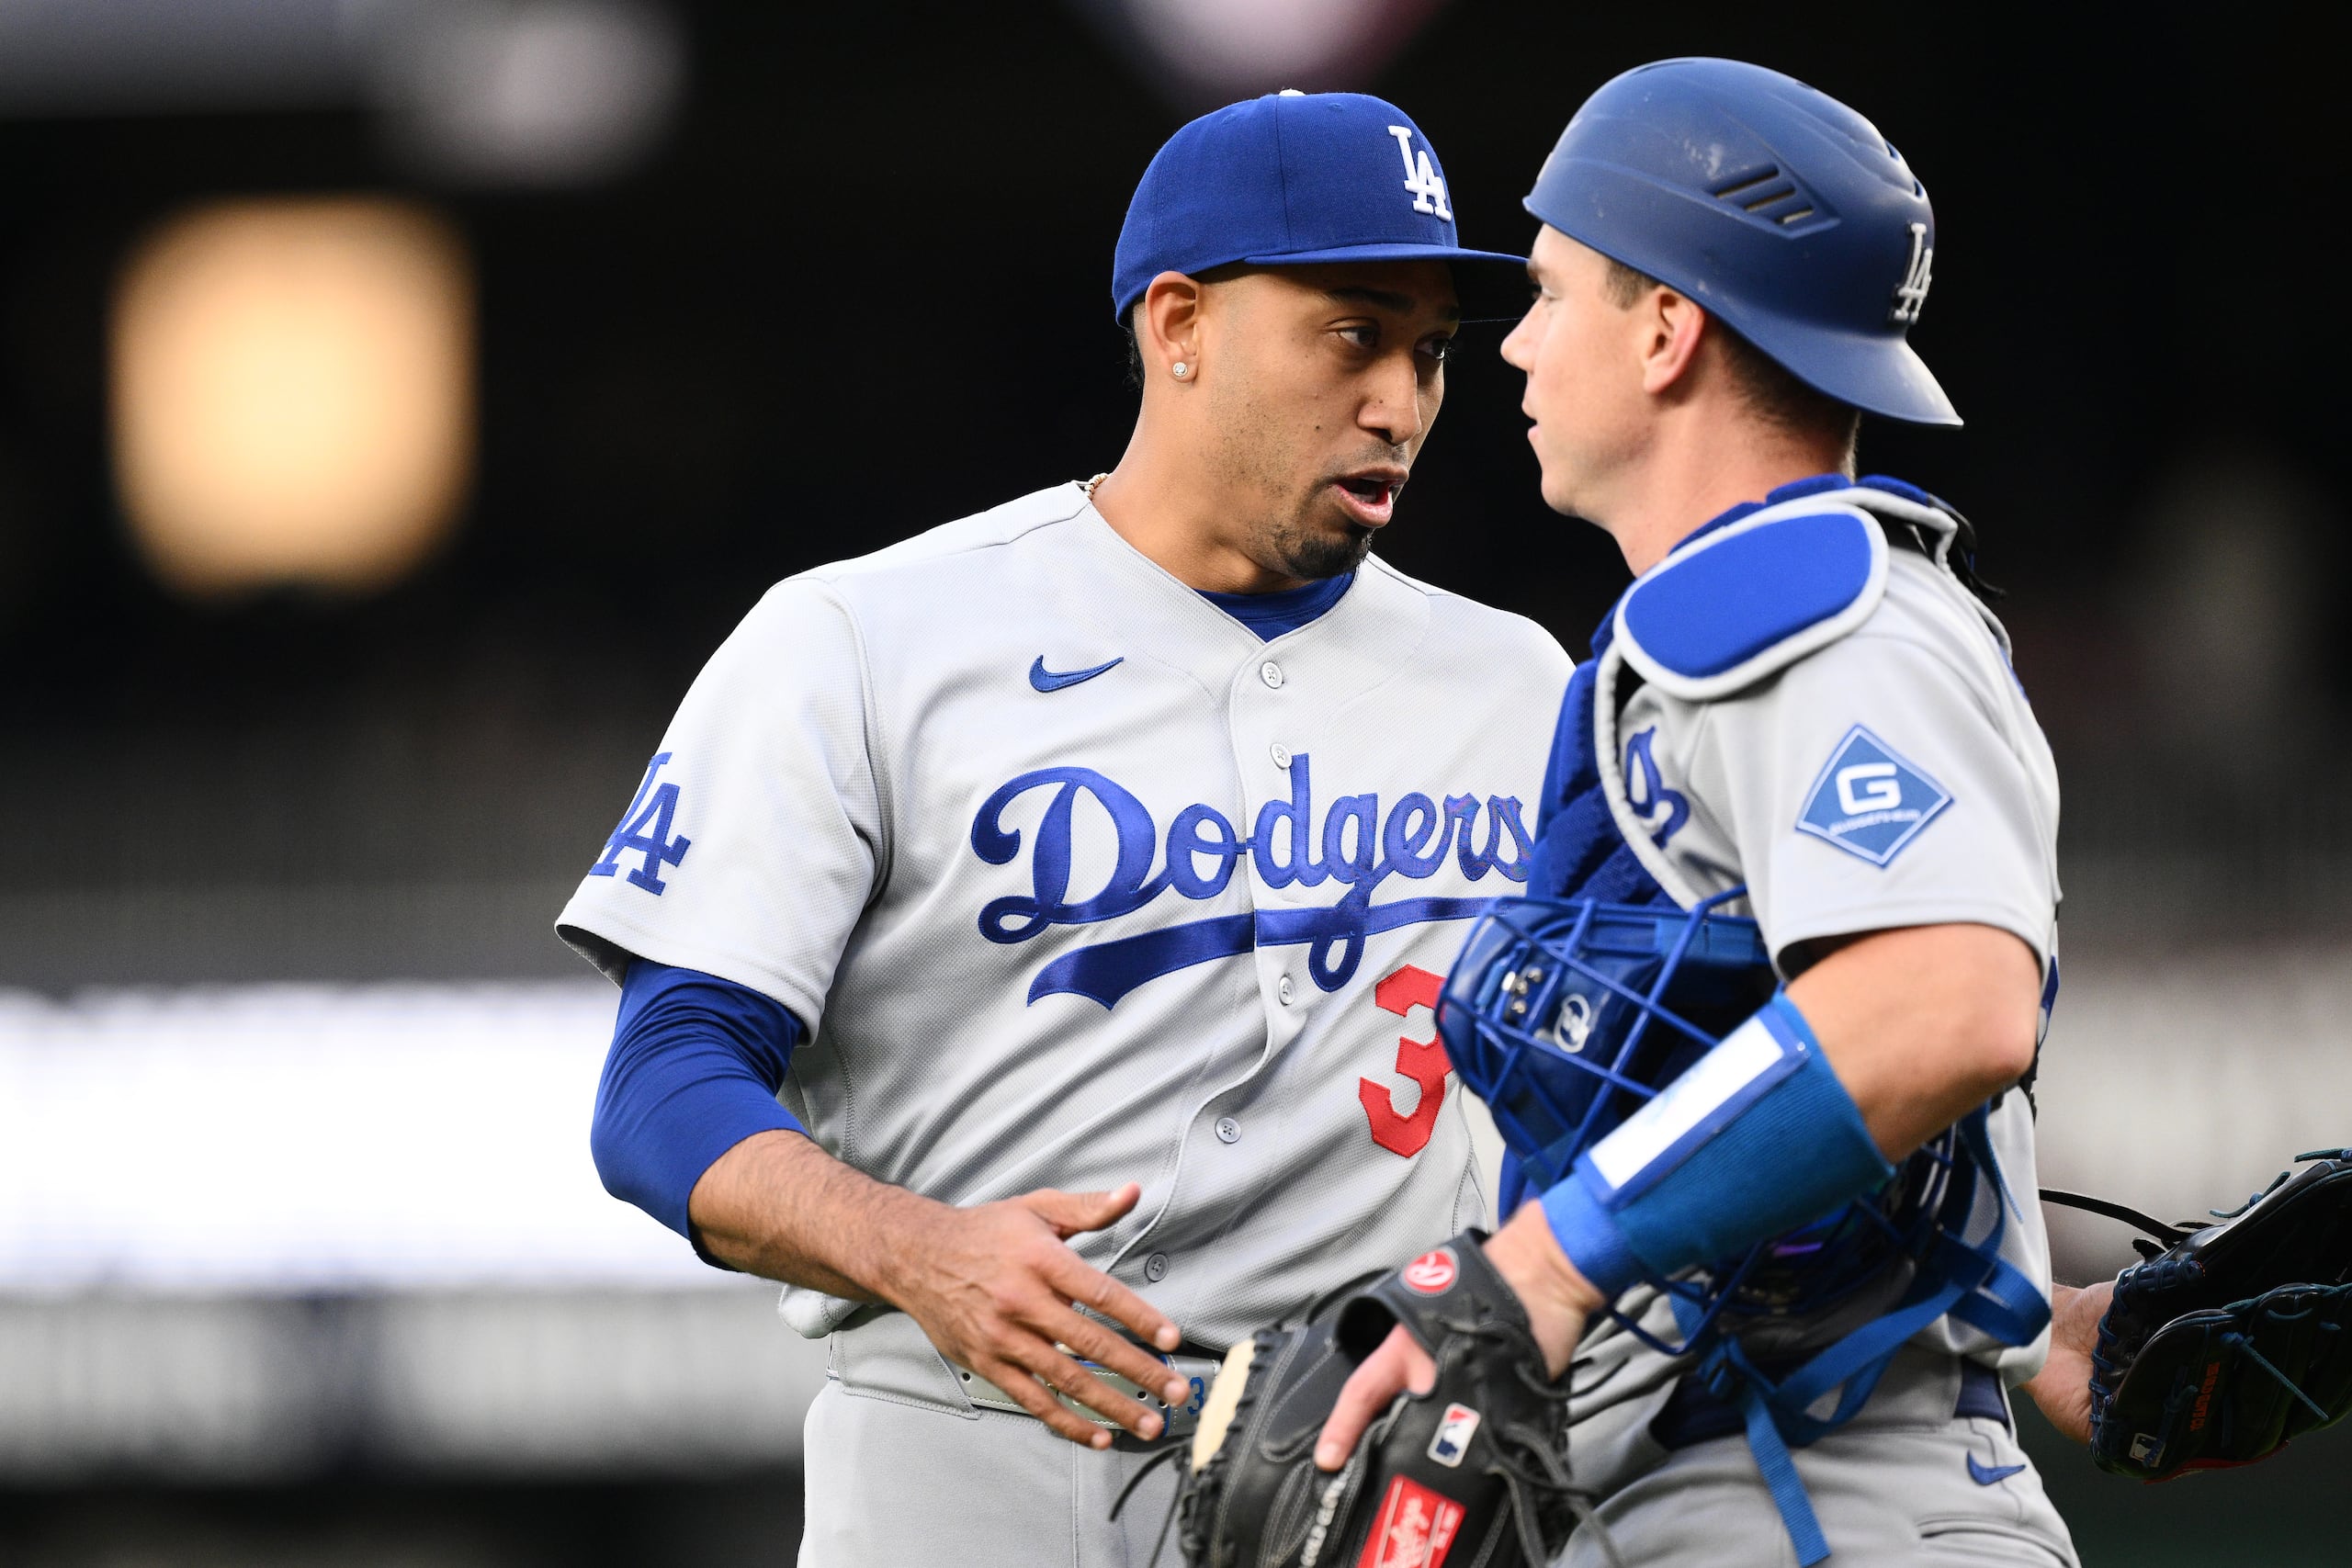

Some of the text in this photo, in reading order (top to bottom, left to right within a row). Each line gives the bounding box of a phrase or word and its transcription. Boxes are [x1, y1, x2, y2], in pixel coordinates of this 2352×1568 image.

[1387, 125, 1452, 221] LA
[1894, 222, 1932, 324] LA
[589, 751, 691, 896] LA
[1836, 761, 1902, 817] G
[971, 753, 1534, 992] Dodgers
[1359, 964, 1453, 1157] 3
[1187, 1376, 1204, 1416] 3
